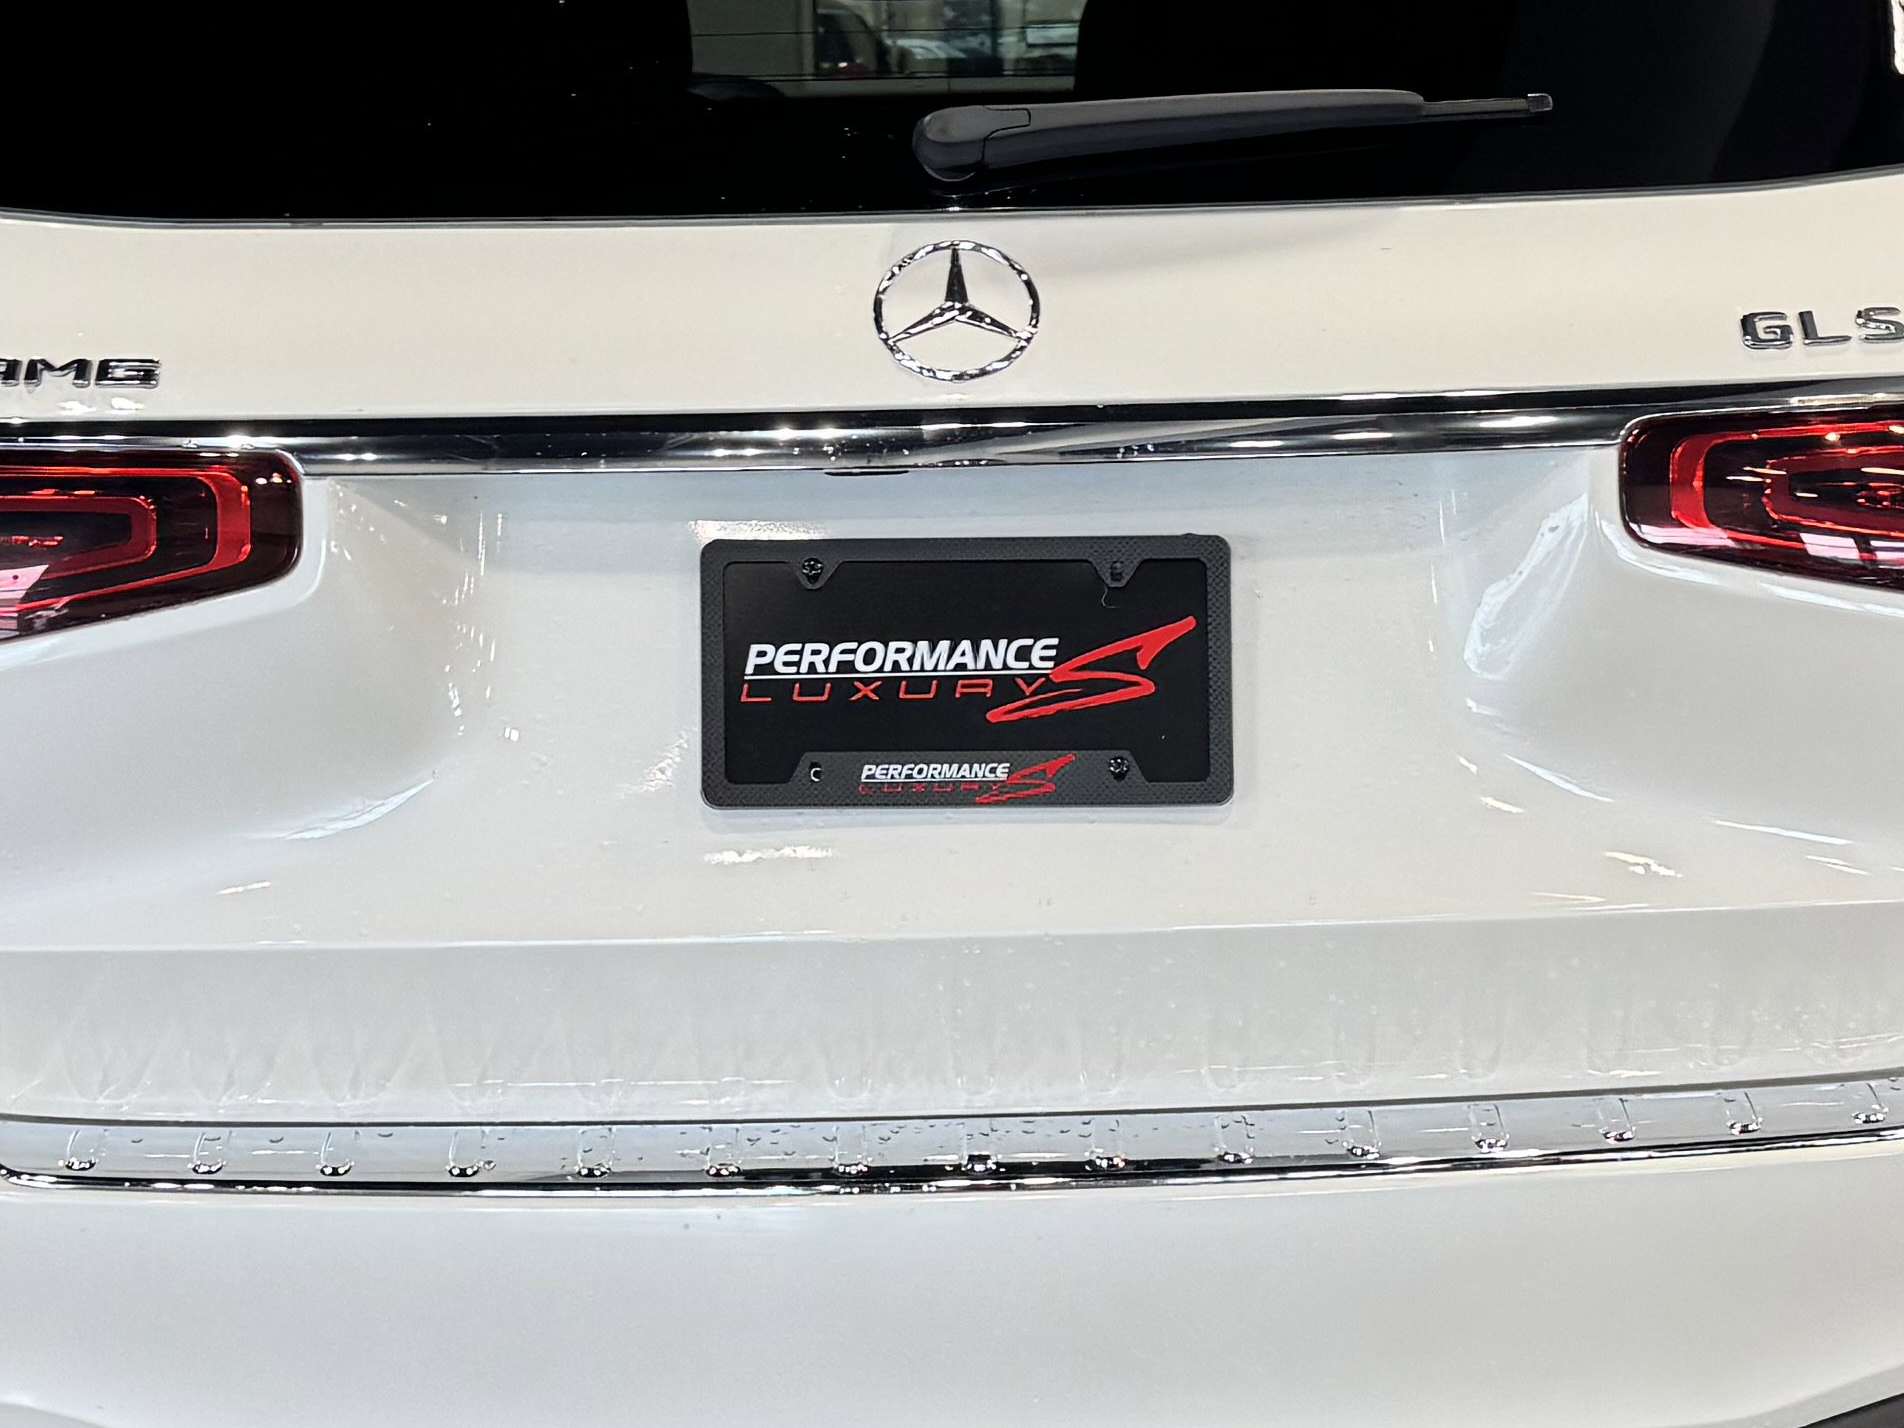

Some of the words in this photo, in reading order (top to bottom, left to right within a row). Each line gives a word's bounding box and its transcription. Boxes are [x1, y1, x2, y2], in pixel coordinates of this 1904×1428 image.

[744, 637, 1060, 675] PERFORMANCE
[740, 677, 1046, 702] LUXURY
[861, 763, 1011, 780] PERFORMANCE
